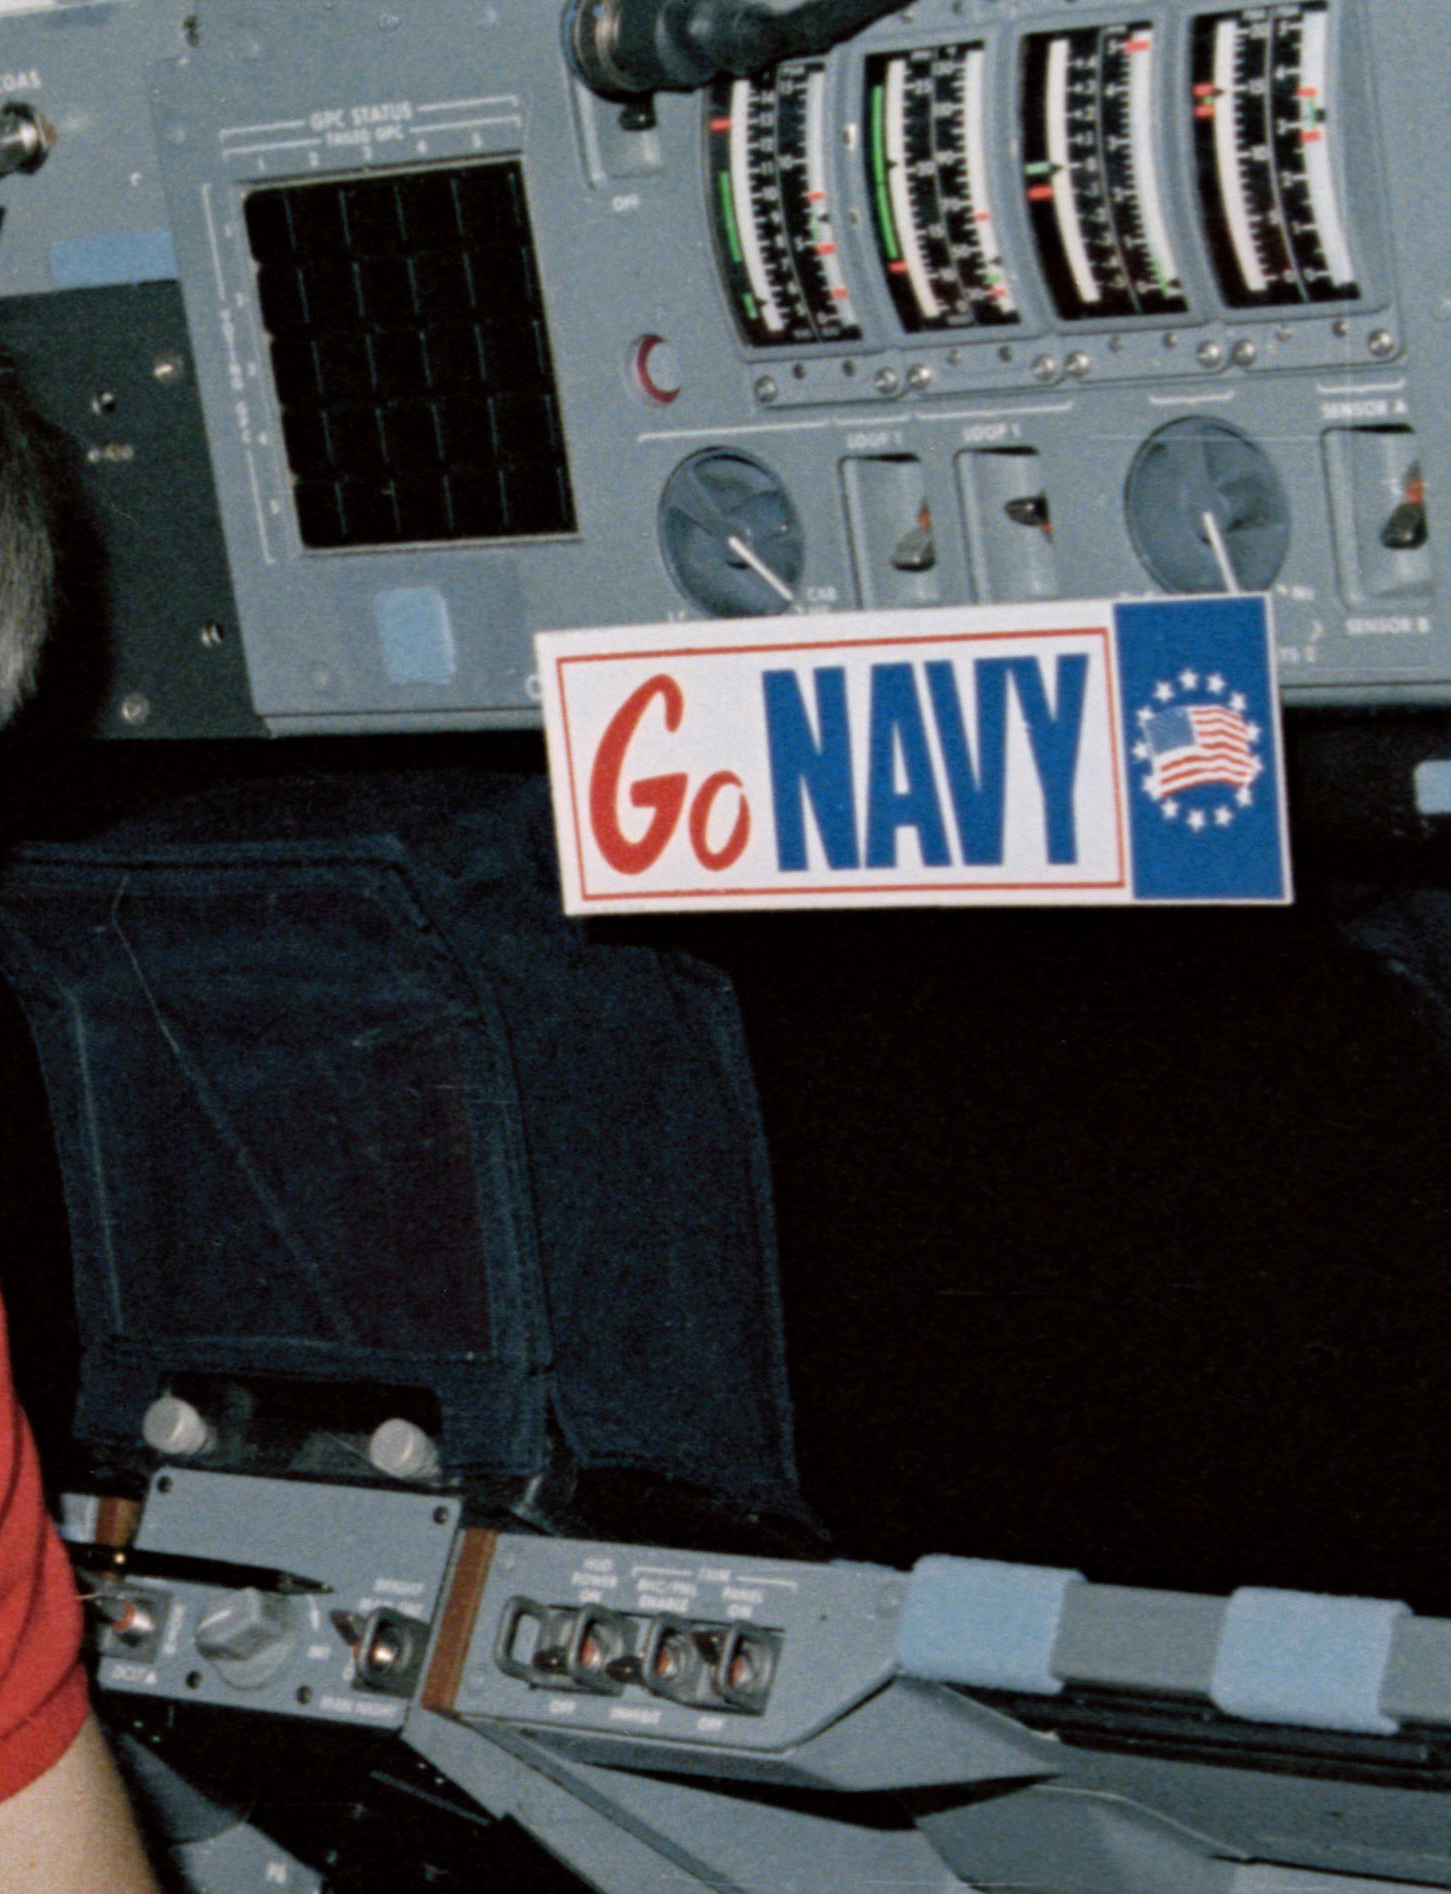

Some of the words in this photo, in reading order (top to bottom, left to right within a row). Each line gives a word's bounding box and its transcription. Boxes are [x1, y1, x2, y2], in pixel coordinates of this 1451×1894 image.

[310, 110, 345, 131] GPC
[351, 101, 413, 125] STATUS
[1393, 398, 1409, 415] A
[588, 673, 751, 875] Go
[762, 653, 1089, 873] NAVY
